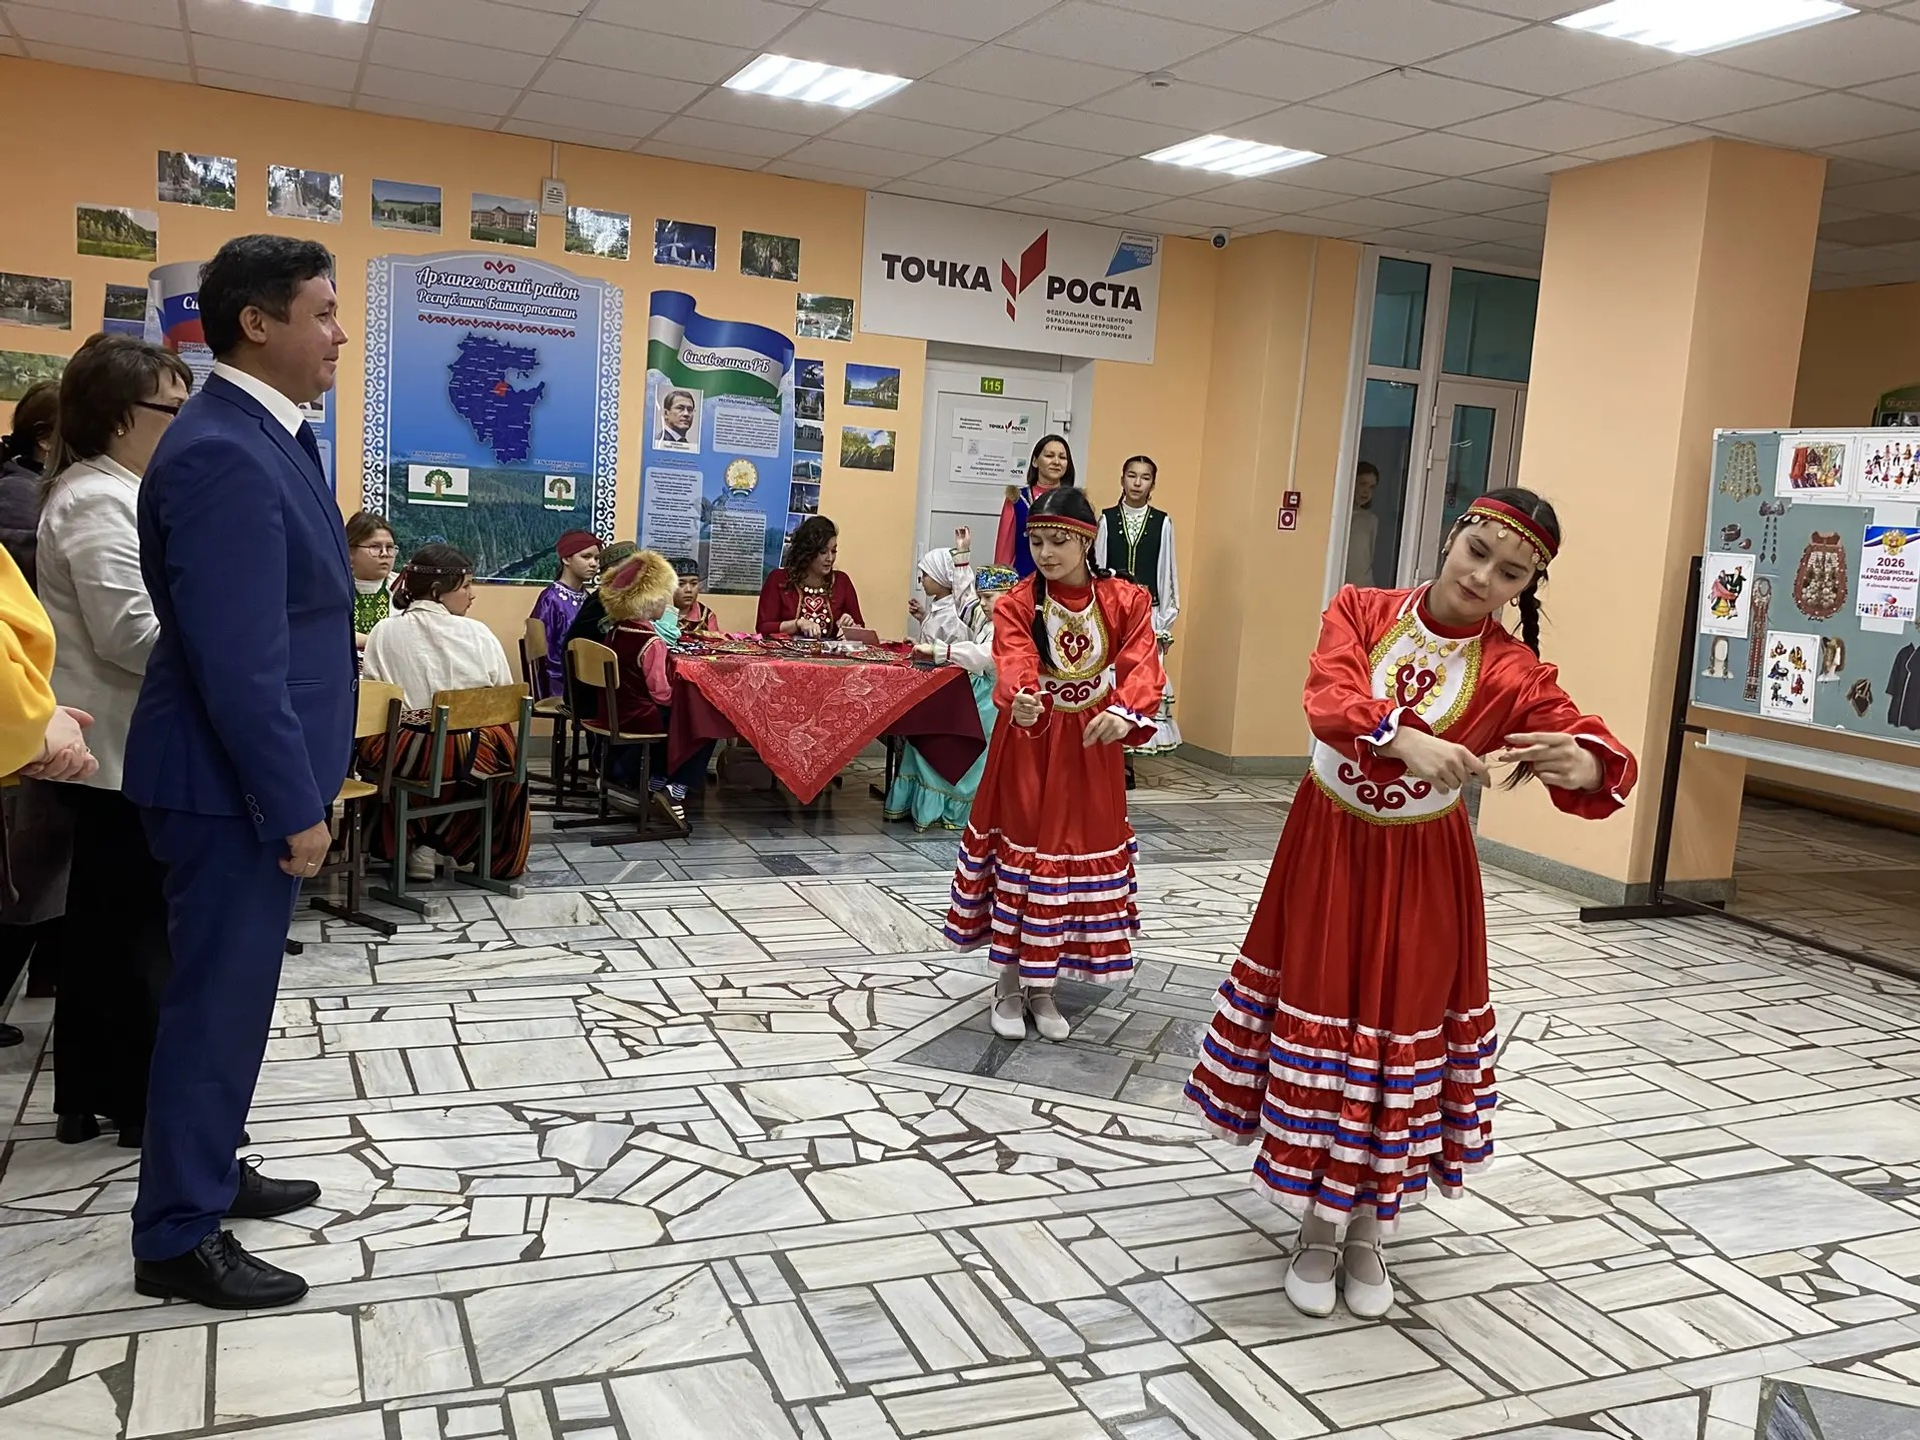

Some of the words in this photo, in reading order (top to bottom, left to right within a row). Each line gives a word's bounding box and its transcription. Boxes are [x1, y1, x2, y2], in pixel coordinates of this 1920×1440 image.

[881, 253, 992, 292] ТОЧКА
[416, 266, 532, 295] Архангельский
[532, 281, 579, 300] район
[1046, 275, 1142, 311] РОСТА
[417, 289, 485, 309] Республики
[486, 297, 577, 318] Башкортостан
[1045, 316, 1089, 327] ОБРАЗОВАНИЯ
[1089, 321, 1126, 332] ЦИФРОВОГО
[1046, 309, 1090, 320] ФЕДЕРАЛЬНАЯ
[1106, 316, 1133, 325] ЦЕНТРОВ
[1050, 325, 1100, 337] ГУМАНИТАРНОГО
[1101, 330, 1133, 340] ПРОФИЛЕЙ
[683, 349, 751, 371] Символика
[751, 358, 771, 373] РБ
[983, 380, 1001, 392] 115
[1877, 557, 1906, 568] 2026
[1861, 574, 1891, 582] НАРОДОВ
[1866, 567, 1879, 575] ГОД
[1880, 568, 1915, 576] ЕДИНСТВА
